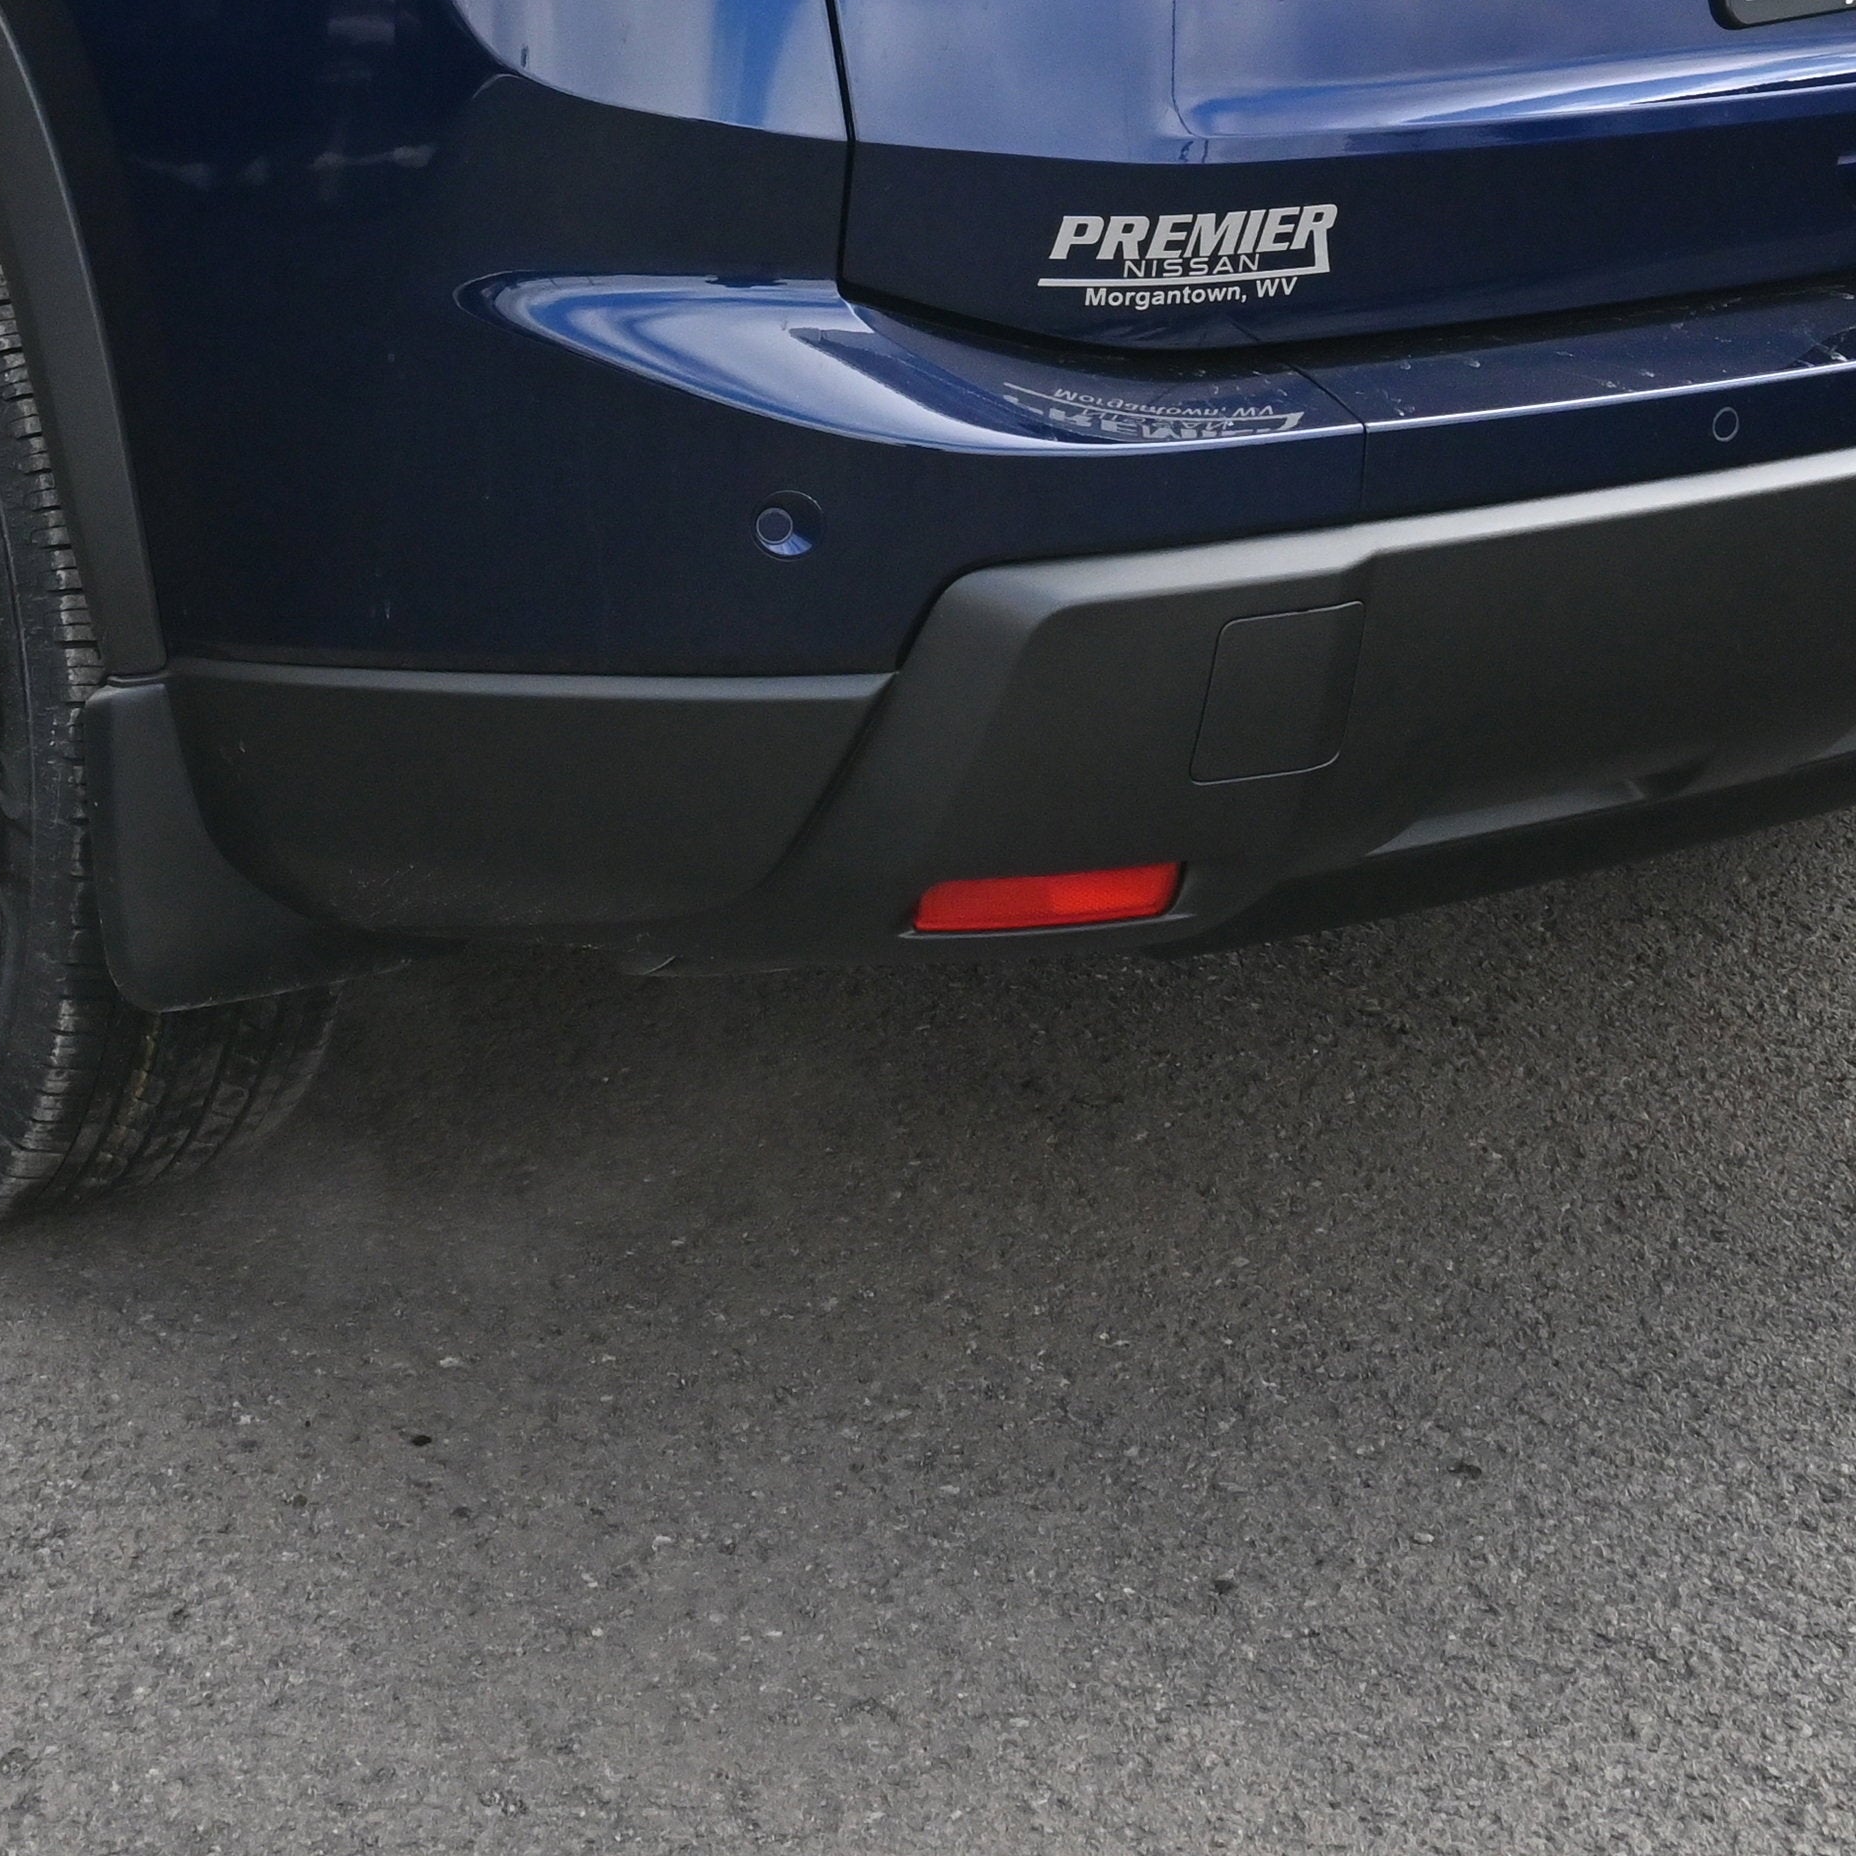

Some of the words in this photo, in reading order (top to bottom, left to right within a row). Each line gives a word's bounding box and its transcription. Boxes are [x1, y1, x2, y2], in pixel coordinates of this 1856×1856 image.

[1048, 204, 1338, 266] PREMIER
[1123, 253, 1261, 279] NISSAN
[1084, 284, 1248, 311] Morgantown,
[1255, 276, 1299, 299] WV
